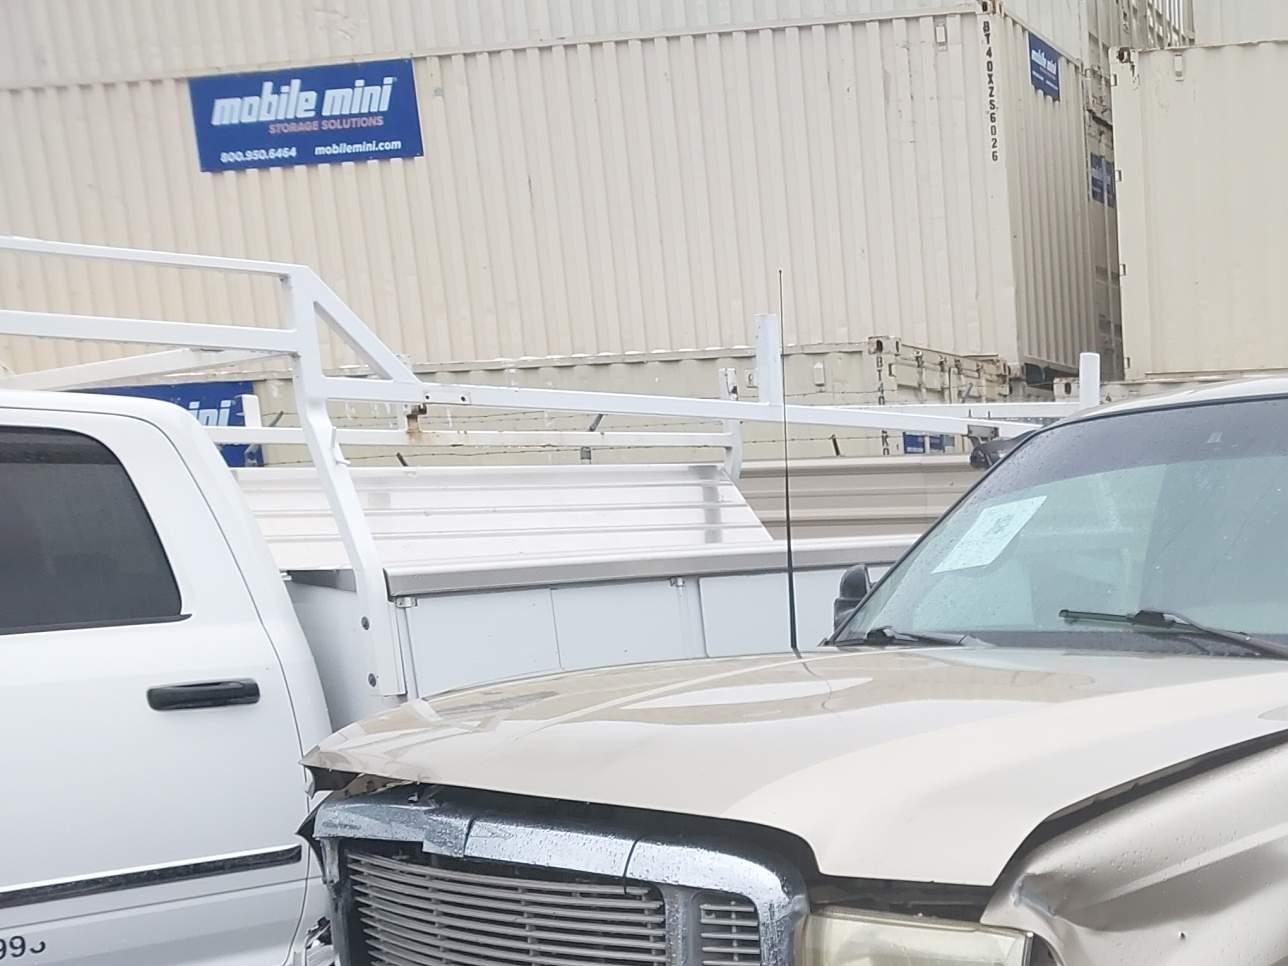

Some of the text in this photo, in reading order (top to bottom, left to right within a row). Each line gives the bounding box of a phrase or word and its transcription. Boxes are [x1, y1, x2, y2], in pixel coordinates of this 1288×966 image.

[211, 76, 393, 125] mobile mini
[269, 116, 384, 134] STORAGE SOLUTIONS
[220, 140, 402, 163] 800.950.6464 mobilemini.com
[189, 400, 231, 426] ini
